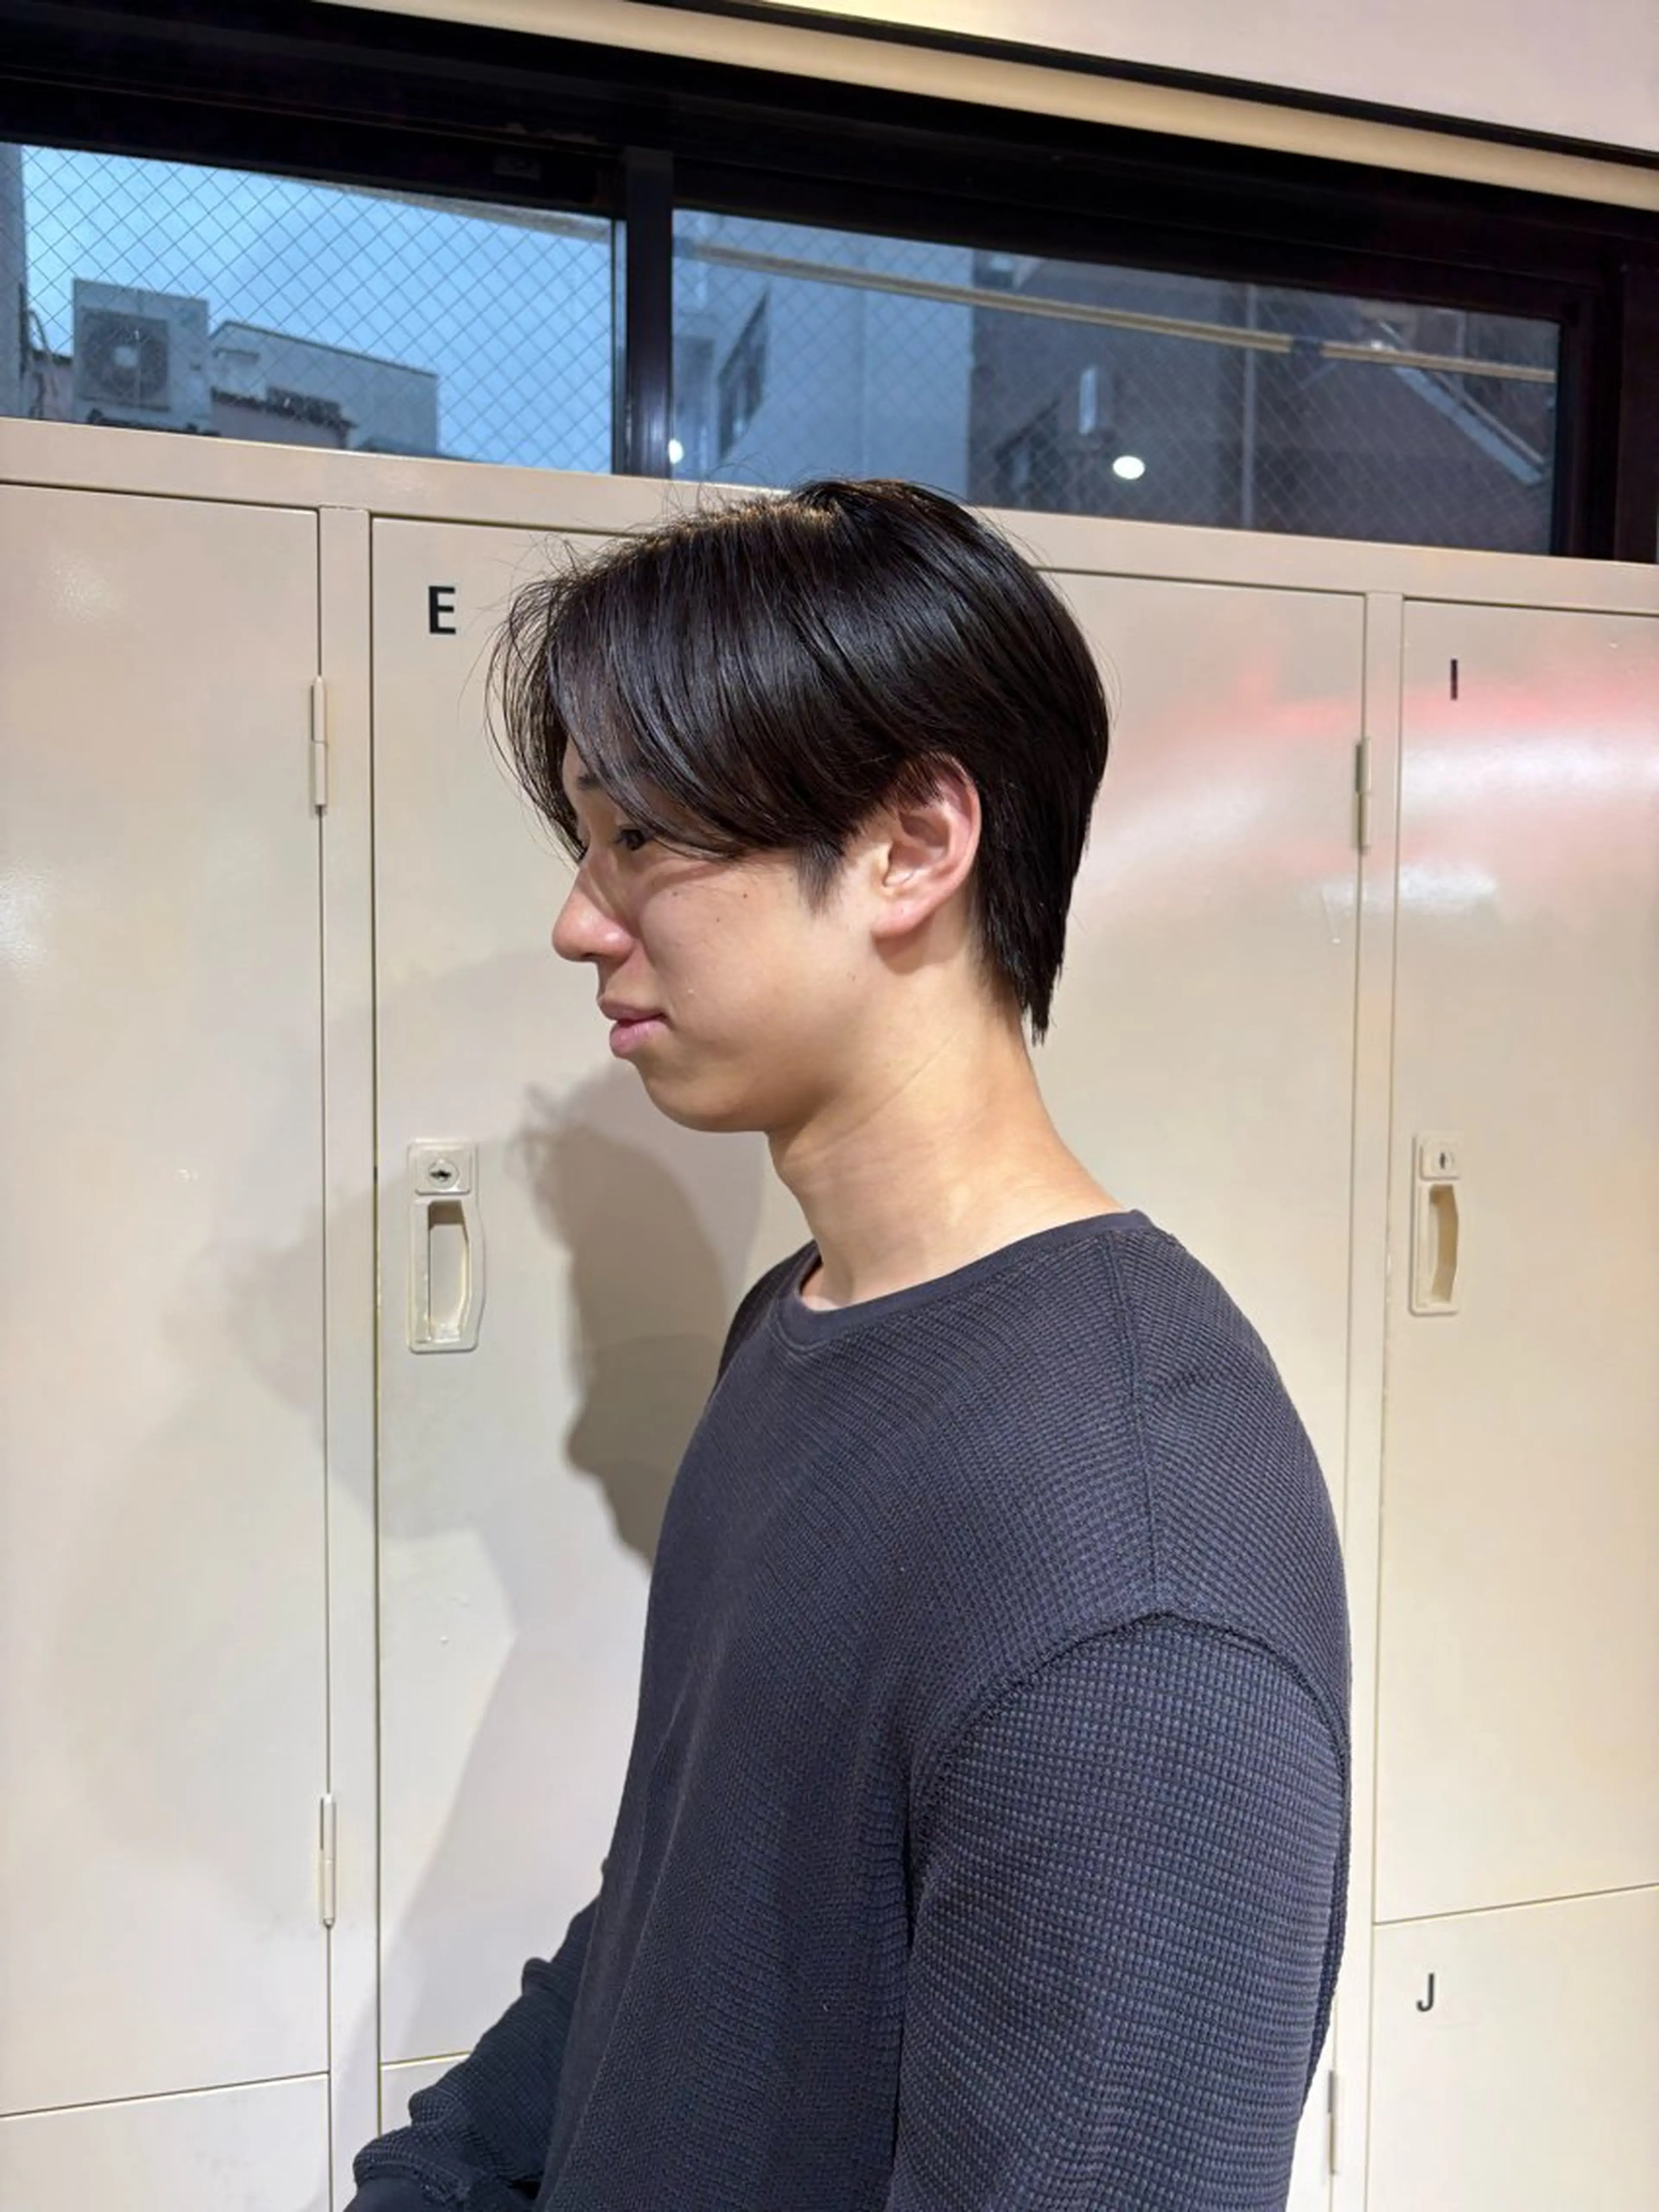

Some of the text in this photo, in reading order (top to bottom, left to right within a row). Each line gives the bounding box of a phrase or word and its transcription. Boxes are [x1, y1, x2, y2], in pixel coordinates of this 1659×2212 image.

[428, 585, 456, 635] E
[1450, 658, 1458, 700] I
[1416, 1973, 1434, 2012] J
